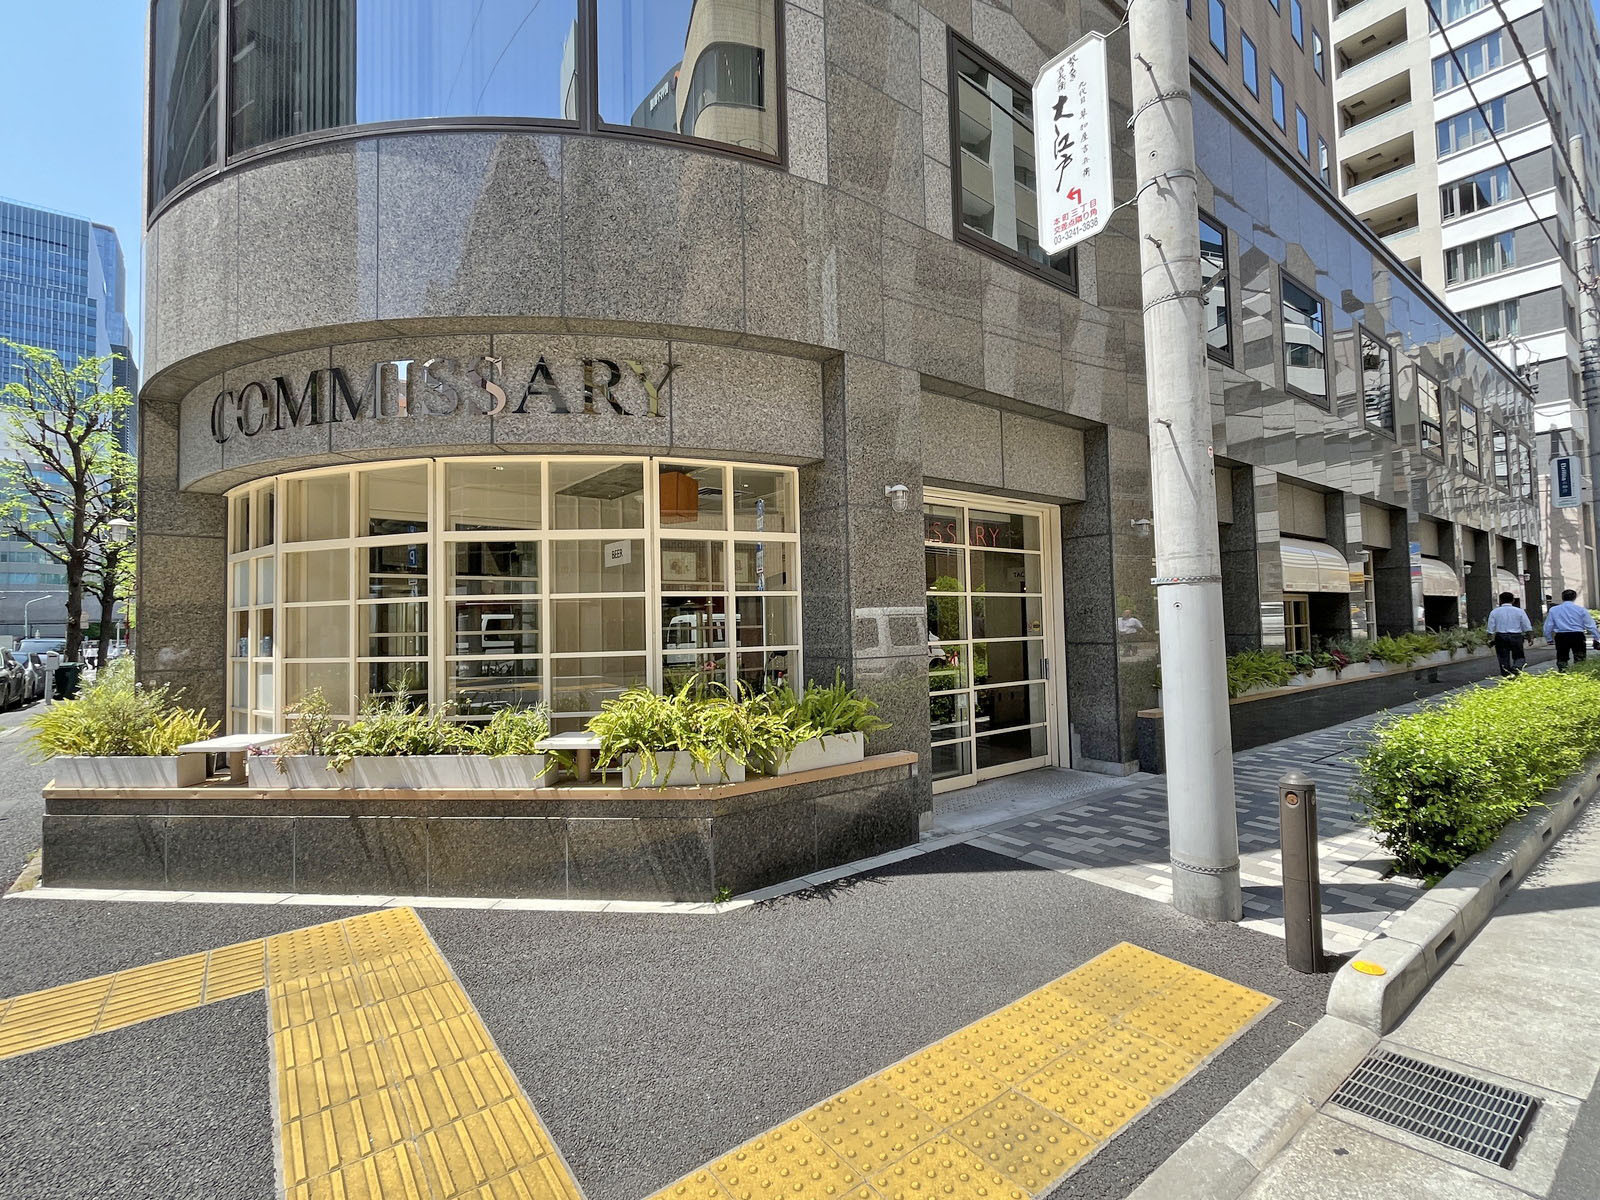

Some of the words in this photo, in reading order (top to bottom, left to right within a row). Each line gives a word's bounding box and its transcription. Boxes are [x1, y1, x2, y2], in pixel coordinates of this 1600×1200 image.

[1053, 198, 1096, 226] 本町三丁目
[211, 356, 682, 444] COMMISSARY
[611, 548, 623, 559] BEER
